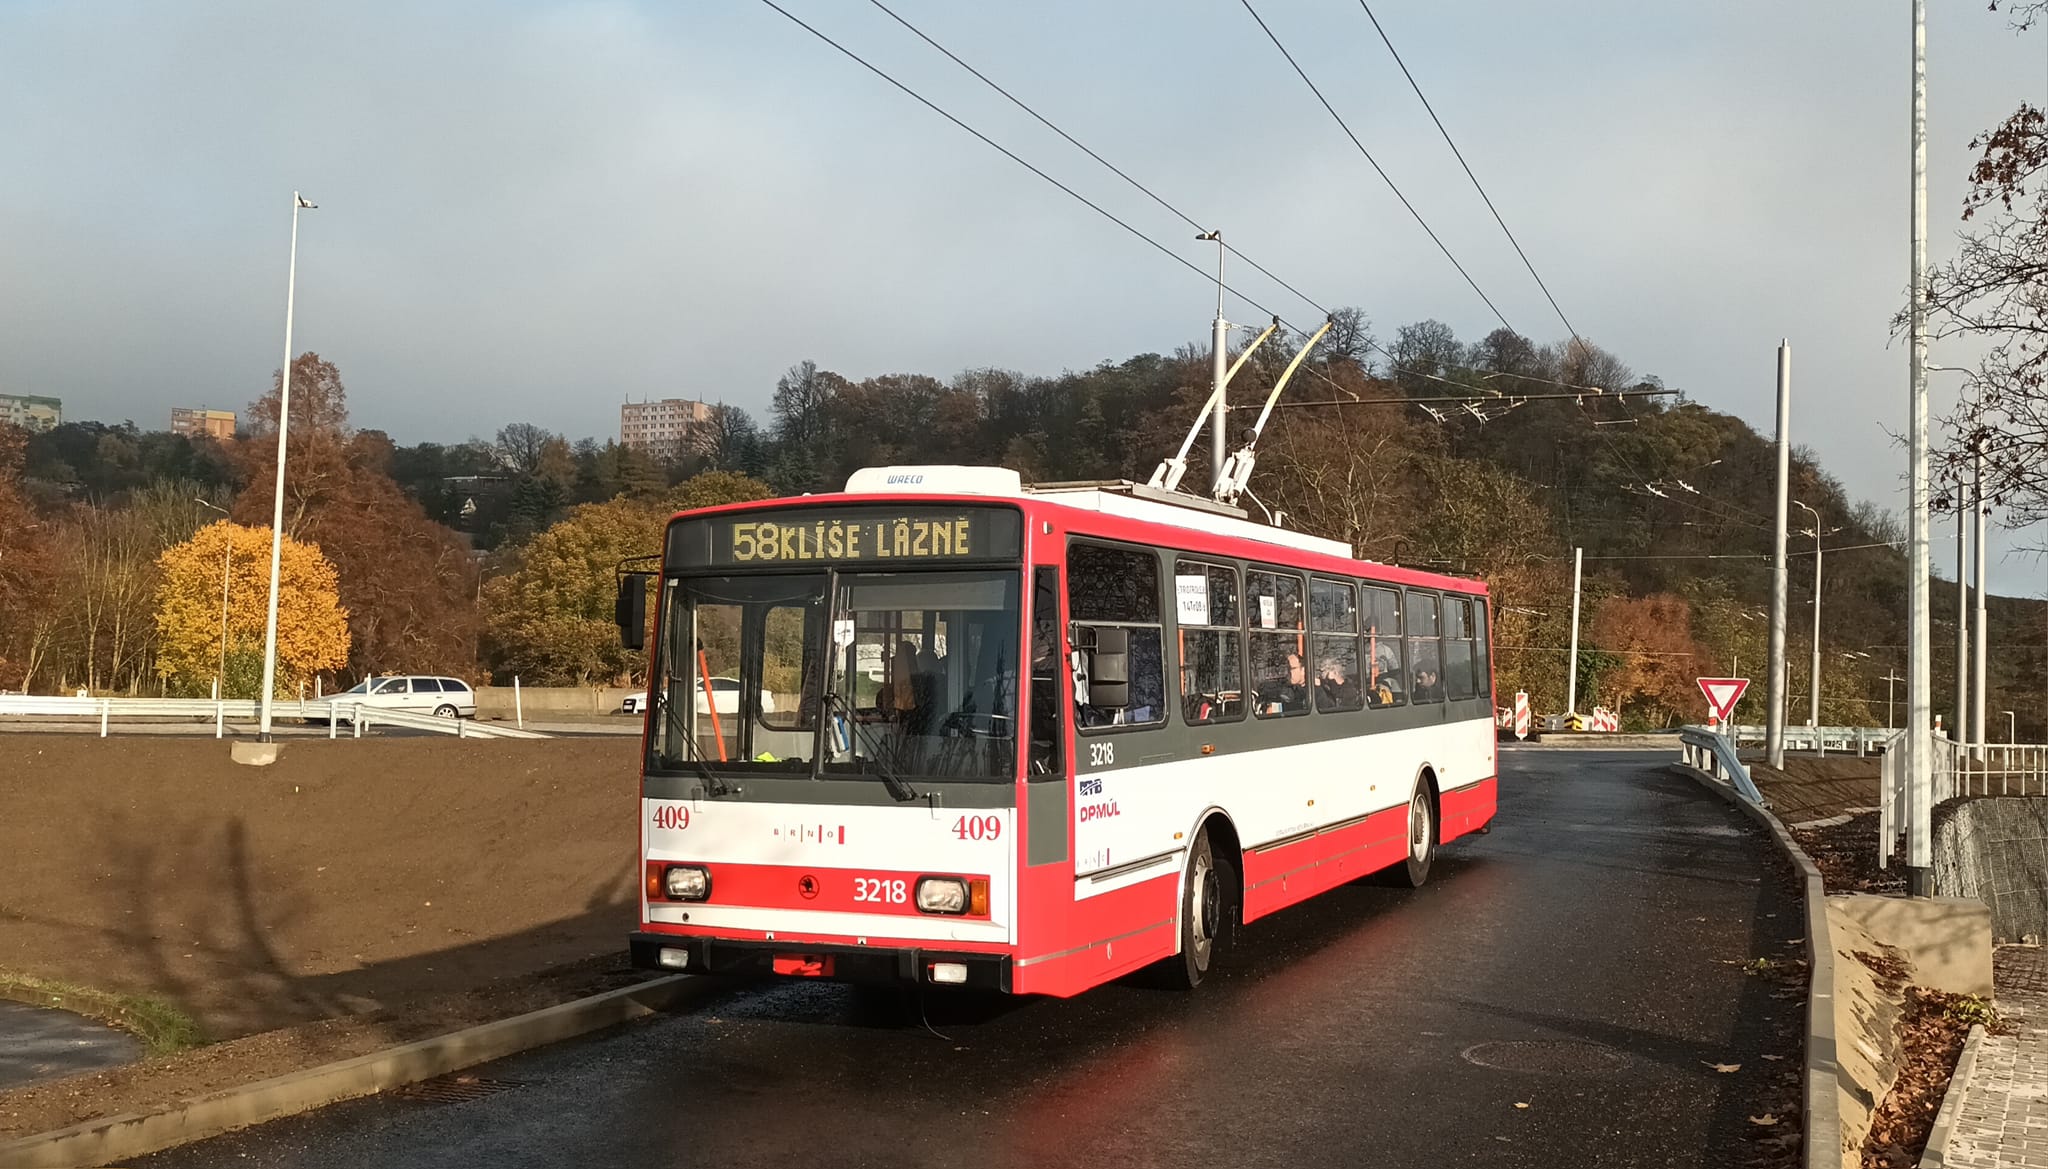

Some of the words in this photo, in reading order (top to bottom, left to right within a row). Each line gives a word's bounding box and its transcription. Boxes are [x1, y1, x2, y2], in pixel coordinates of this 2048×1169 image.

[887, 474, 924, 485] WAECO
[734, 522, 780, 561] 58
[780, 520, 861, 560] KLÍŠE
[1089, 742, 1114, 767] 3218
[652, 805, 690, 830] 409
[1080, 798, 1121, 823] DPMÚL
[951, 815, 1001, 841] 409
[853, 877, 907, 904] 3218
